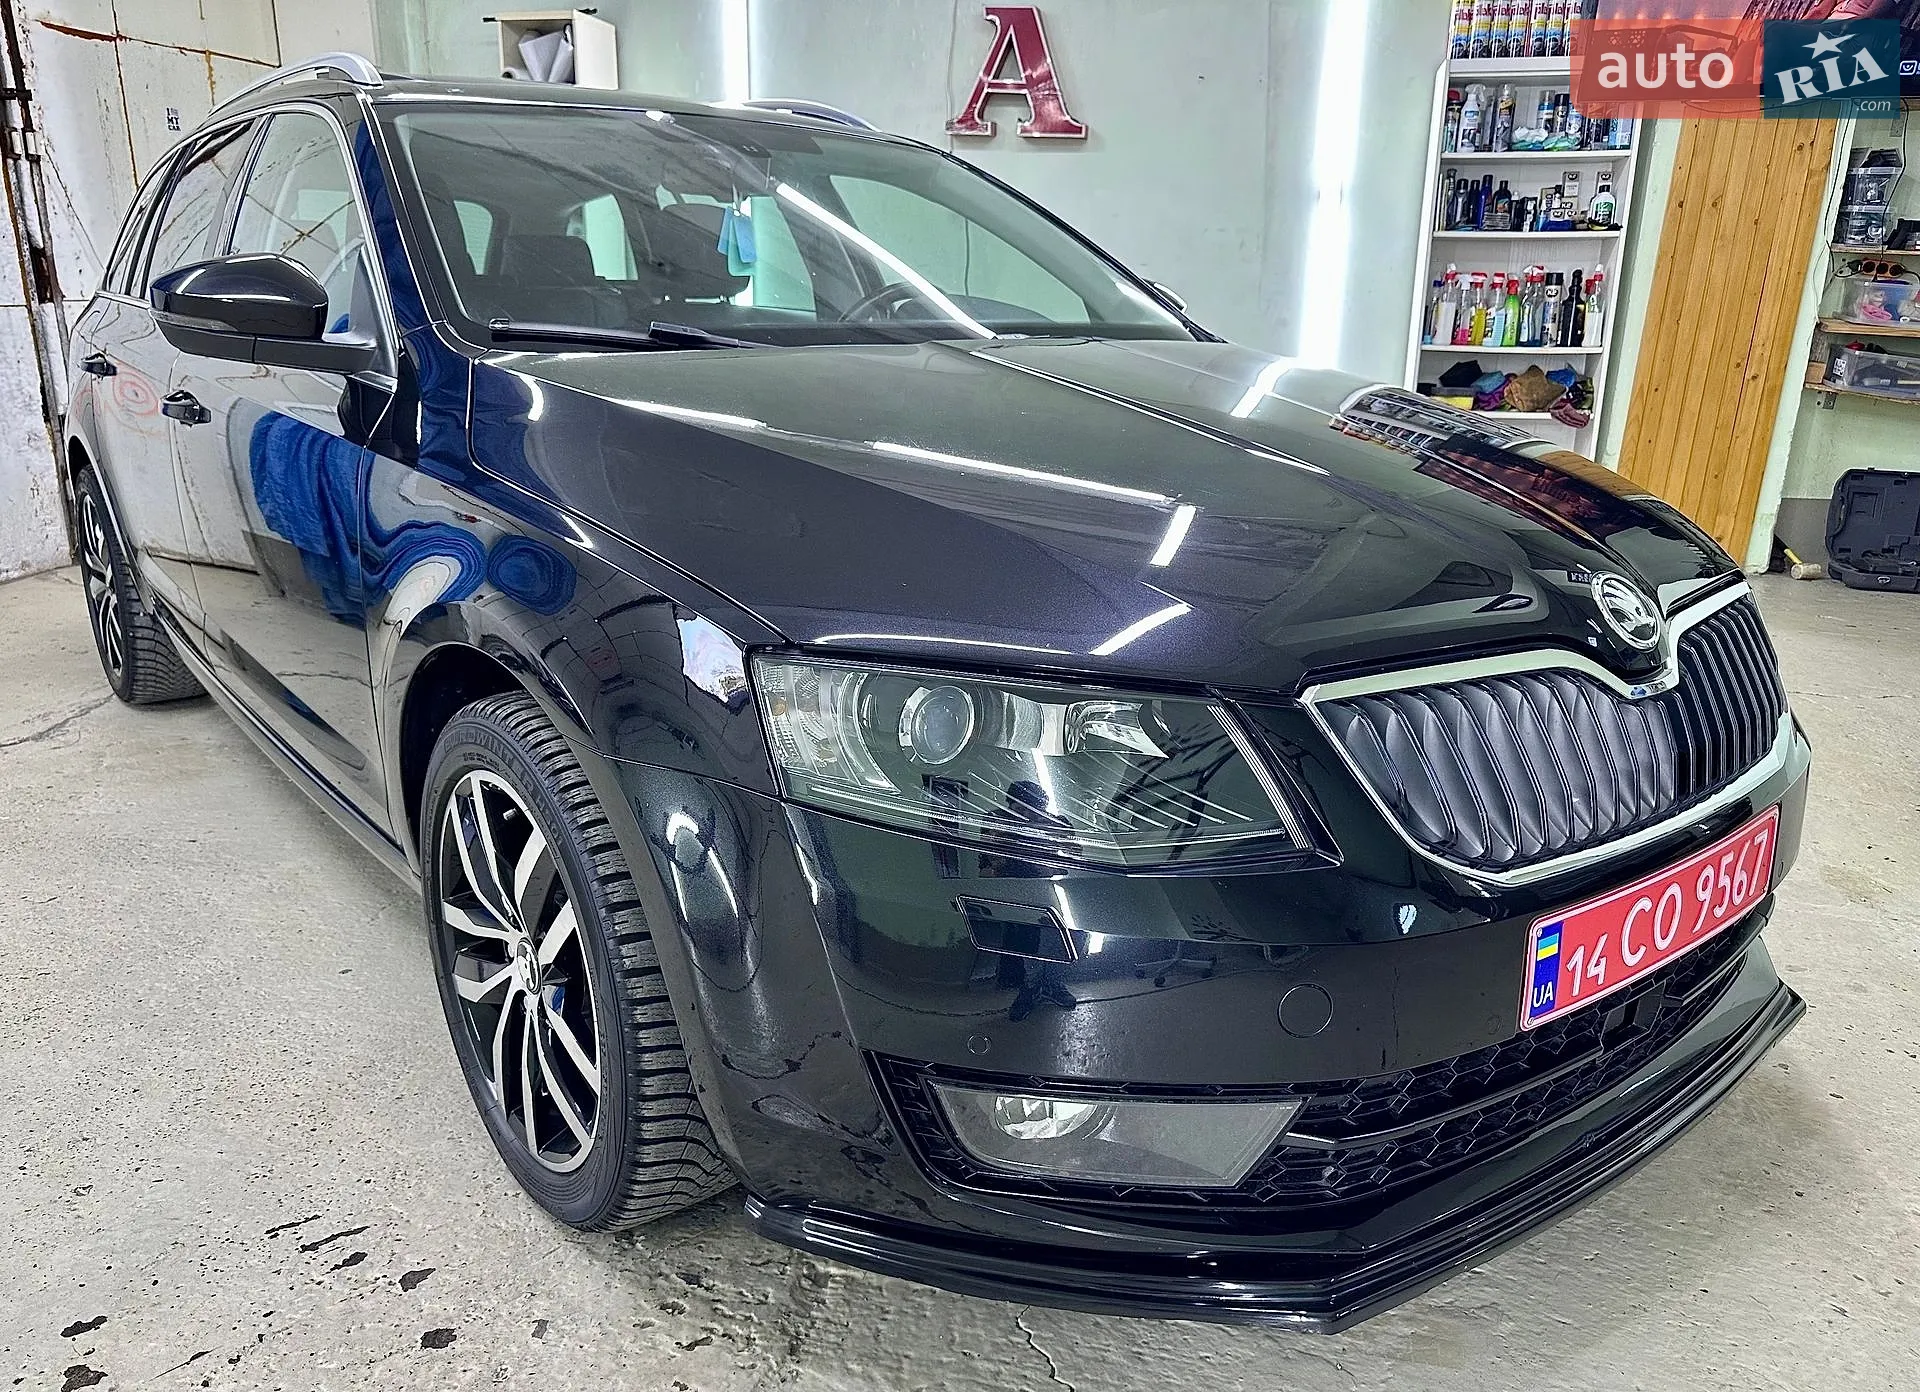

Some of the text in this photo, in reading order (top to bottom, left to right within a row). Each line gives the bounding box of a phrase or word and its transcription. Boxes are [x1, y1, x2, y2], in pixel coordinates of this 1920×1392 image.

[945, 5, 1088, 138] A
[166, 116, 179, 124] MY
[1566, 828, 1768, 997] 14 CO 9567
[1533, 982, 1554, 1008] UA
